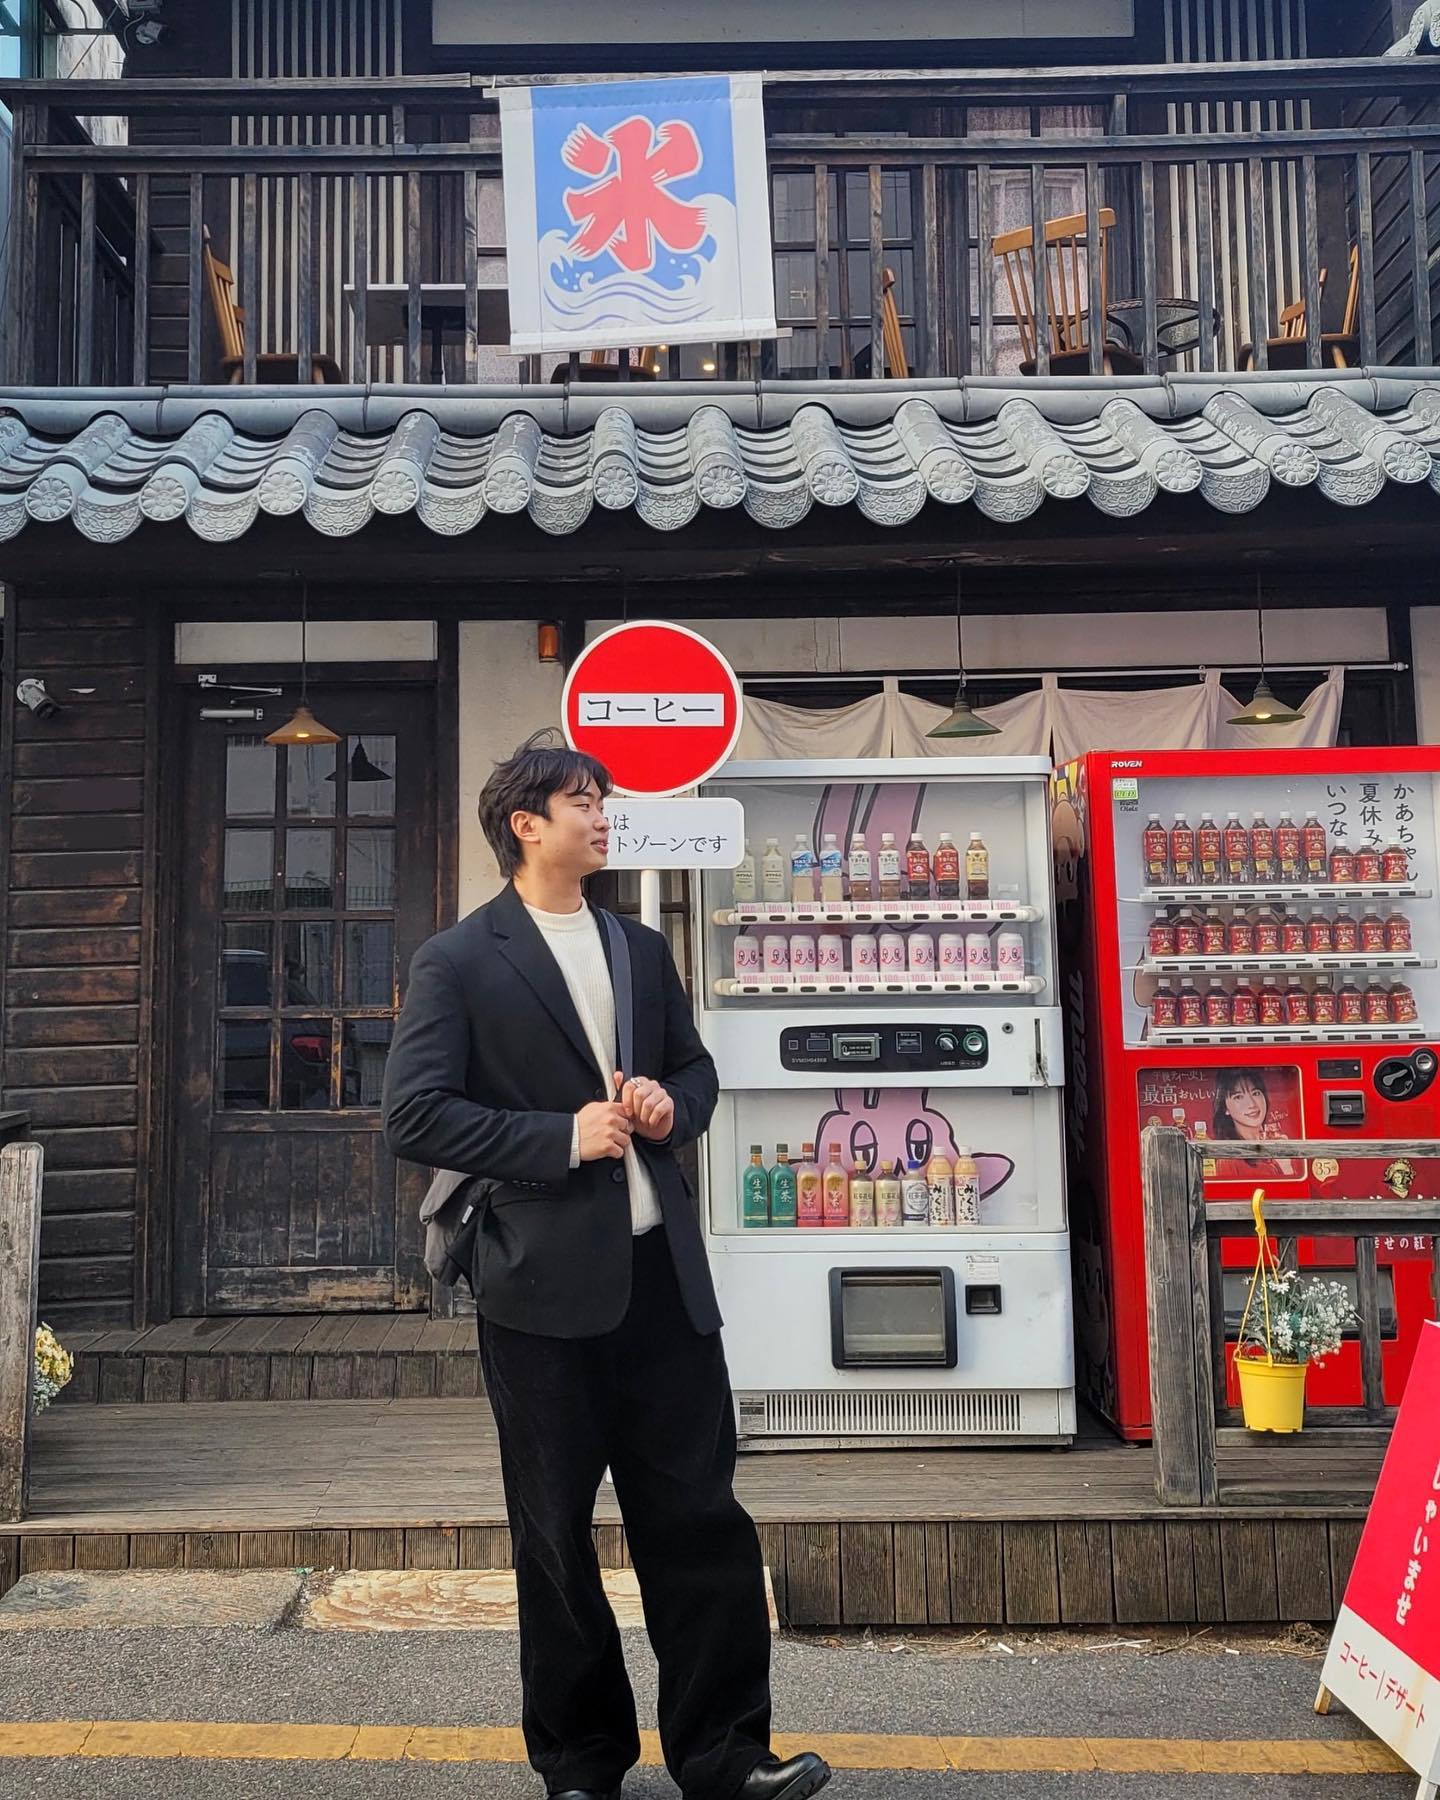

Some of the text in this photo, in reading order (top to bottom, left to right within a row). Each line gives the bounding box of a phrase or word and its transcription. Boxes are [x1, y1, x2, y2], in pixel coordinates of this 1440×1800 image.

[561, 116, 709, 273] 氷
[586, 697, 715, 722] コーヒー
[1111, 760, 1143, 768] ROVEN
[616, 833, 728, 854] トゾーンです
